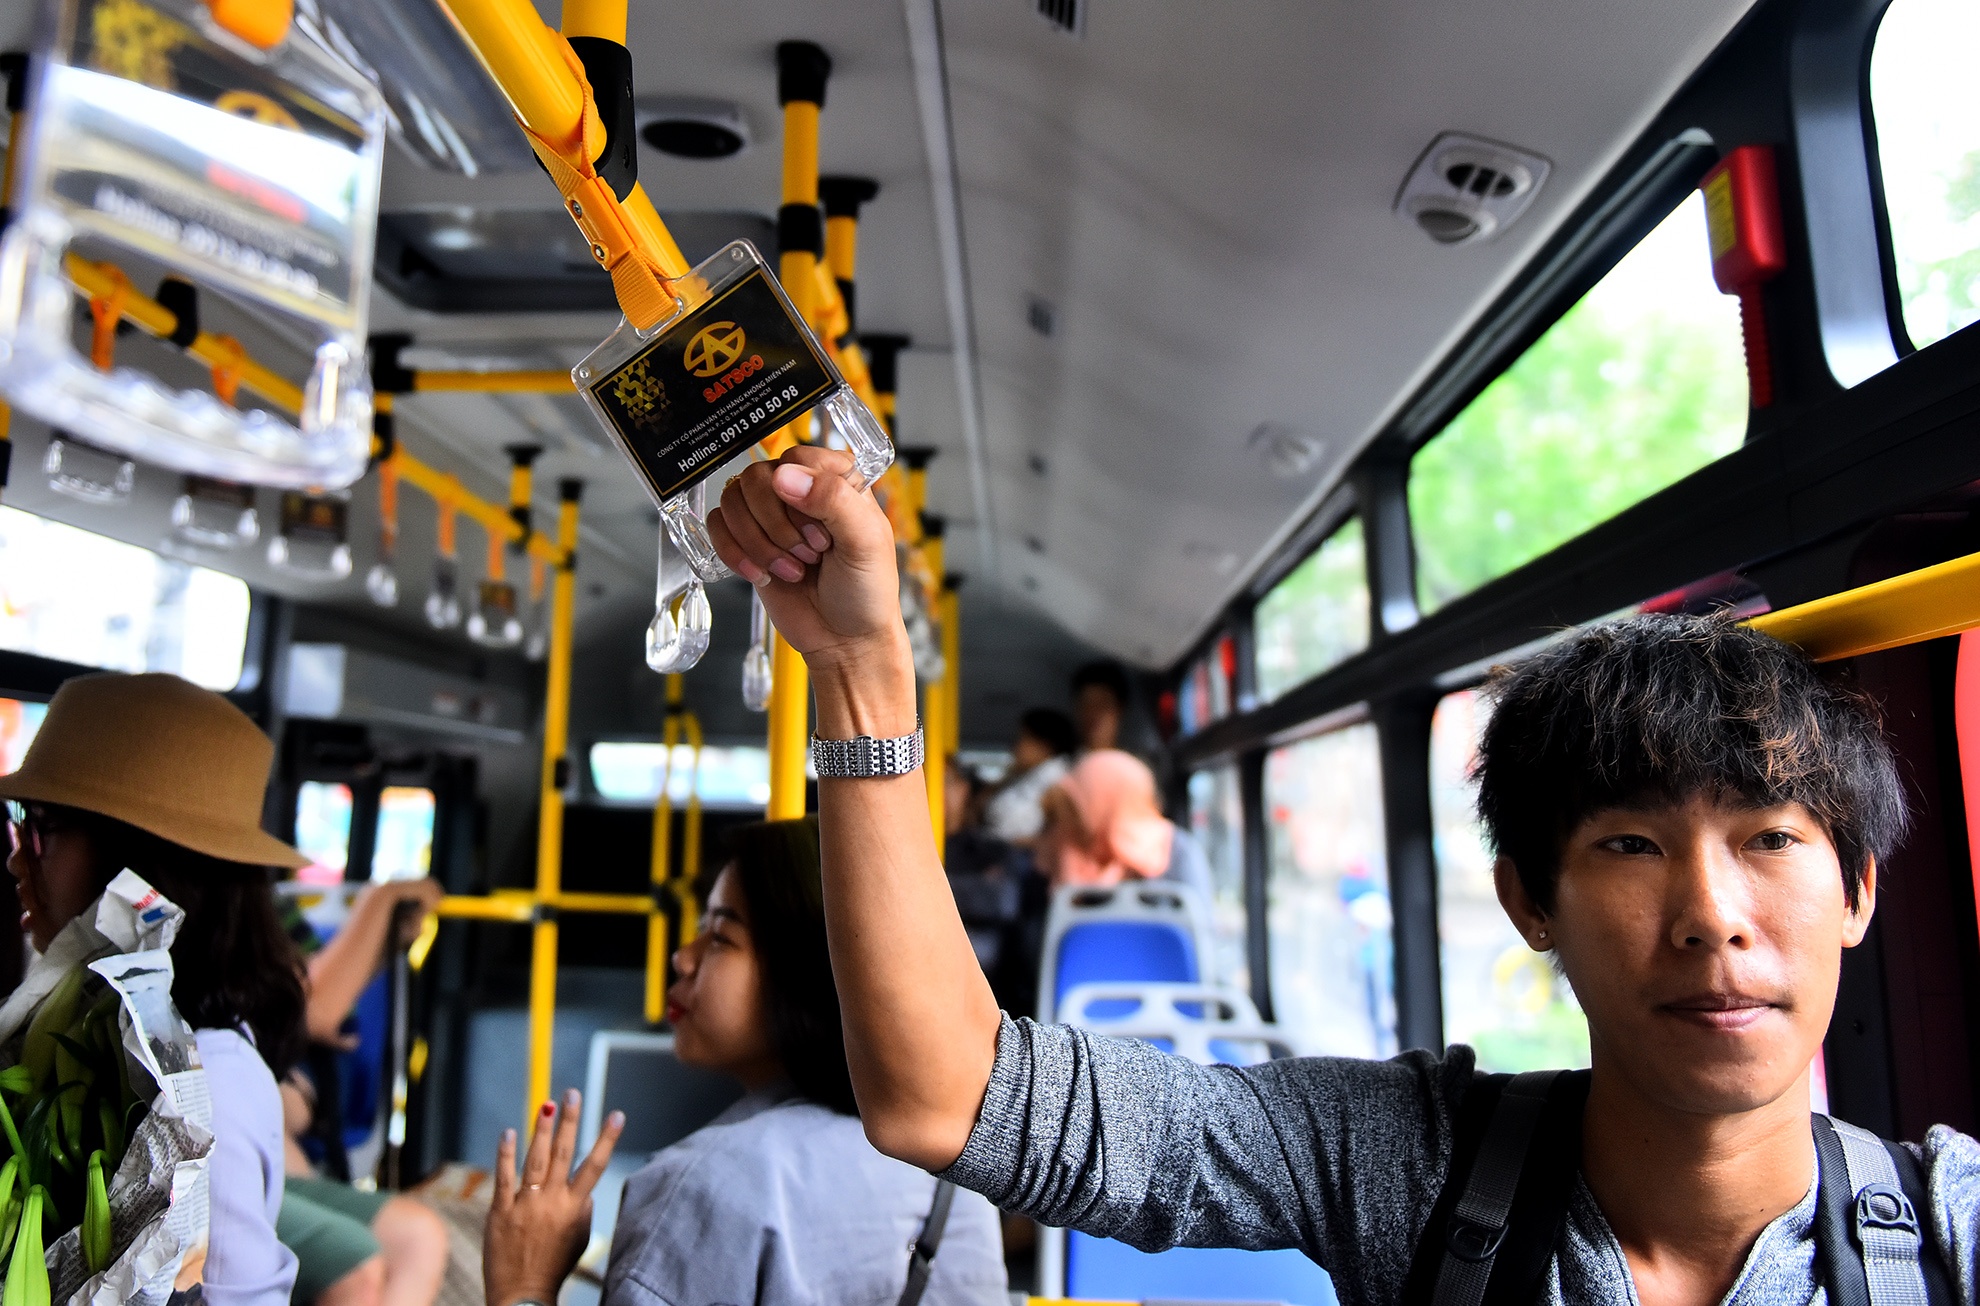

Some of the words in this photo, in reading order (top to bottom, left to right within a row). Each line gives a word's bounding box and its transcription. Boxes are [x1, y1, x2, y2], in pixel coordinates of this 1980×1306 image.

[672, 438, 681, 448] TY
[780, 359, 797, 373] NAM
[703, 354, 764, 403] SATSCO
[759, 387, 772, 398] HCM
[677, 439, 721, 472] Hotline:
[720, 418, 750, 443] 0913
[749, 407, 766, 424] 80
[765, 396, 782, 413] 50
[781, 385, 799, 402] 98
